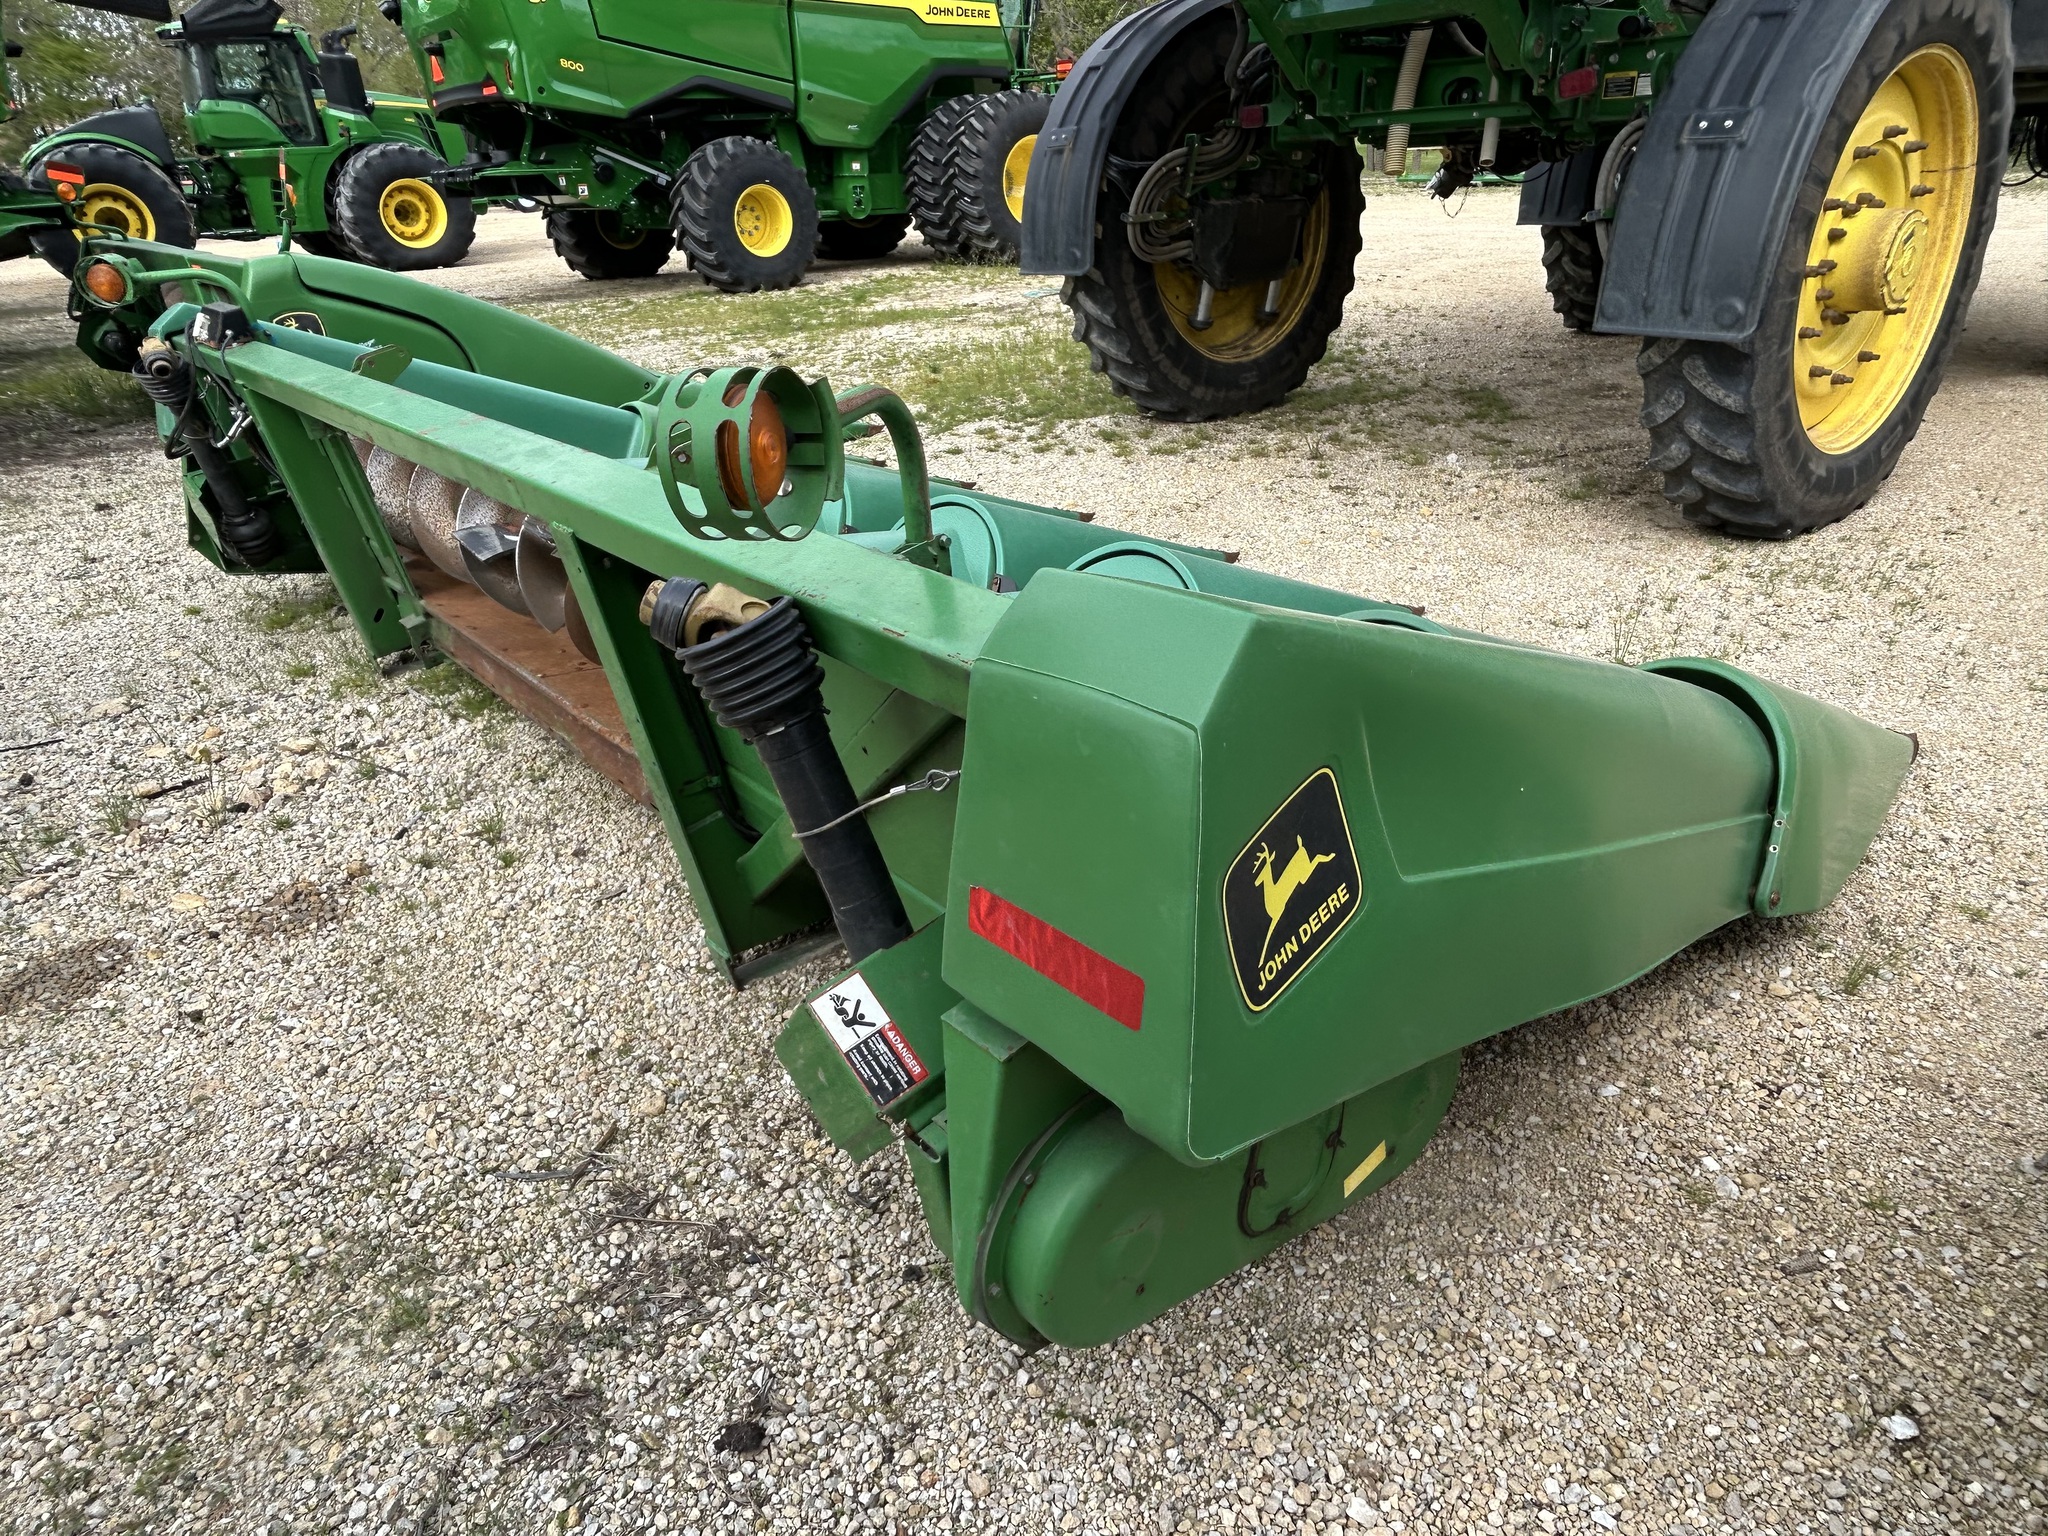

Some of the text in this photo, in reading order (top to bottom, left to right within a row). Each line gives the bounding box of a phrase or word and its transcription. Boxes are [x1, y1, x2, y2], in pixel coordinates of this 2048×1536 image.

[926, 4, 991, 19] JOHN DEERE
[560, 58, 584, 72] 800
[1258, 882, 1350, 991] JOHN DEERE
[890, 1035, 922, 1074] DANGER
